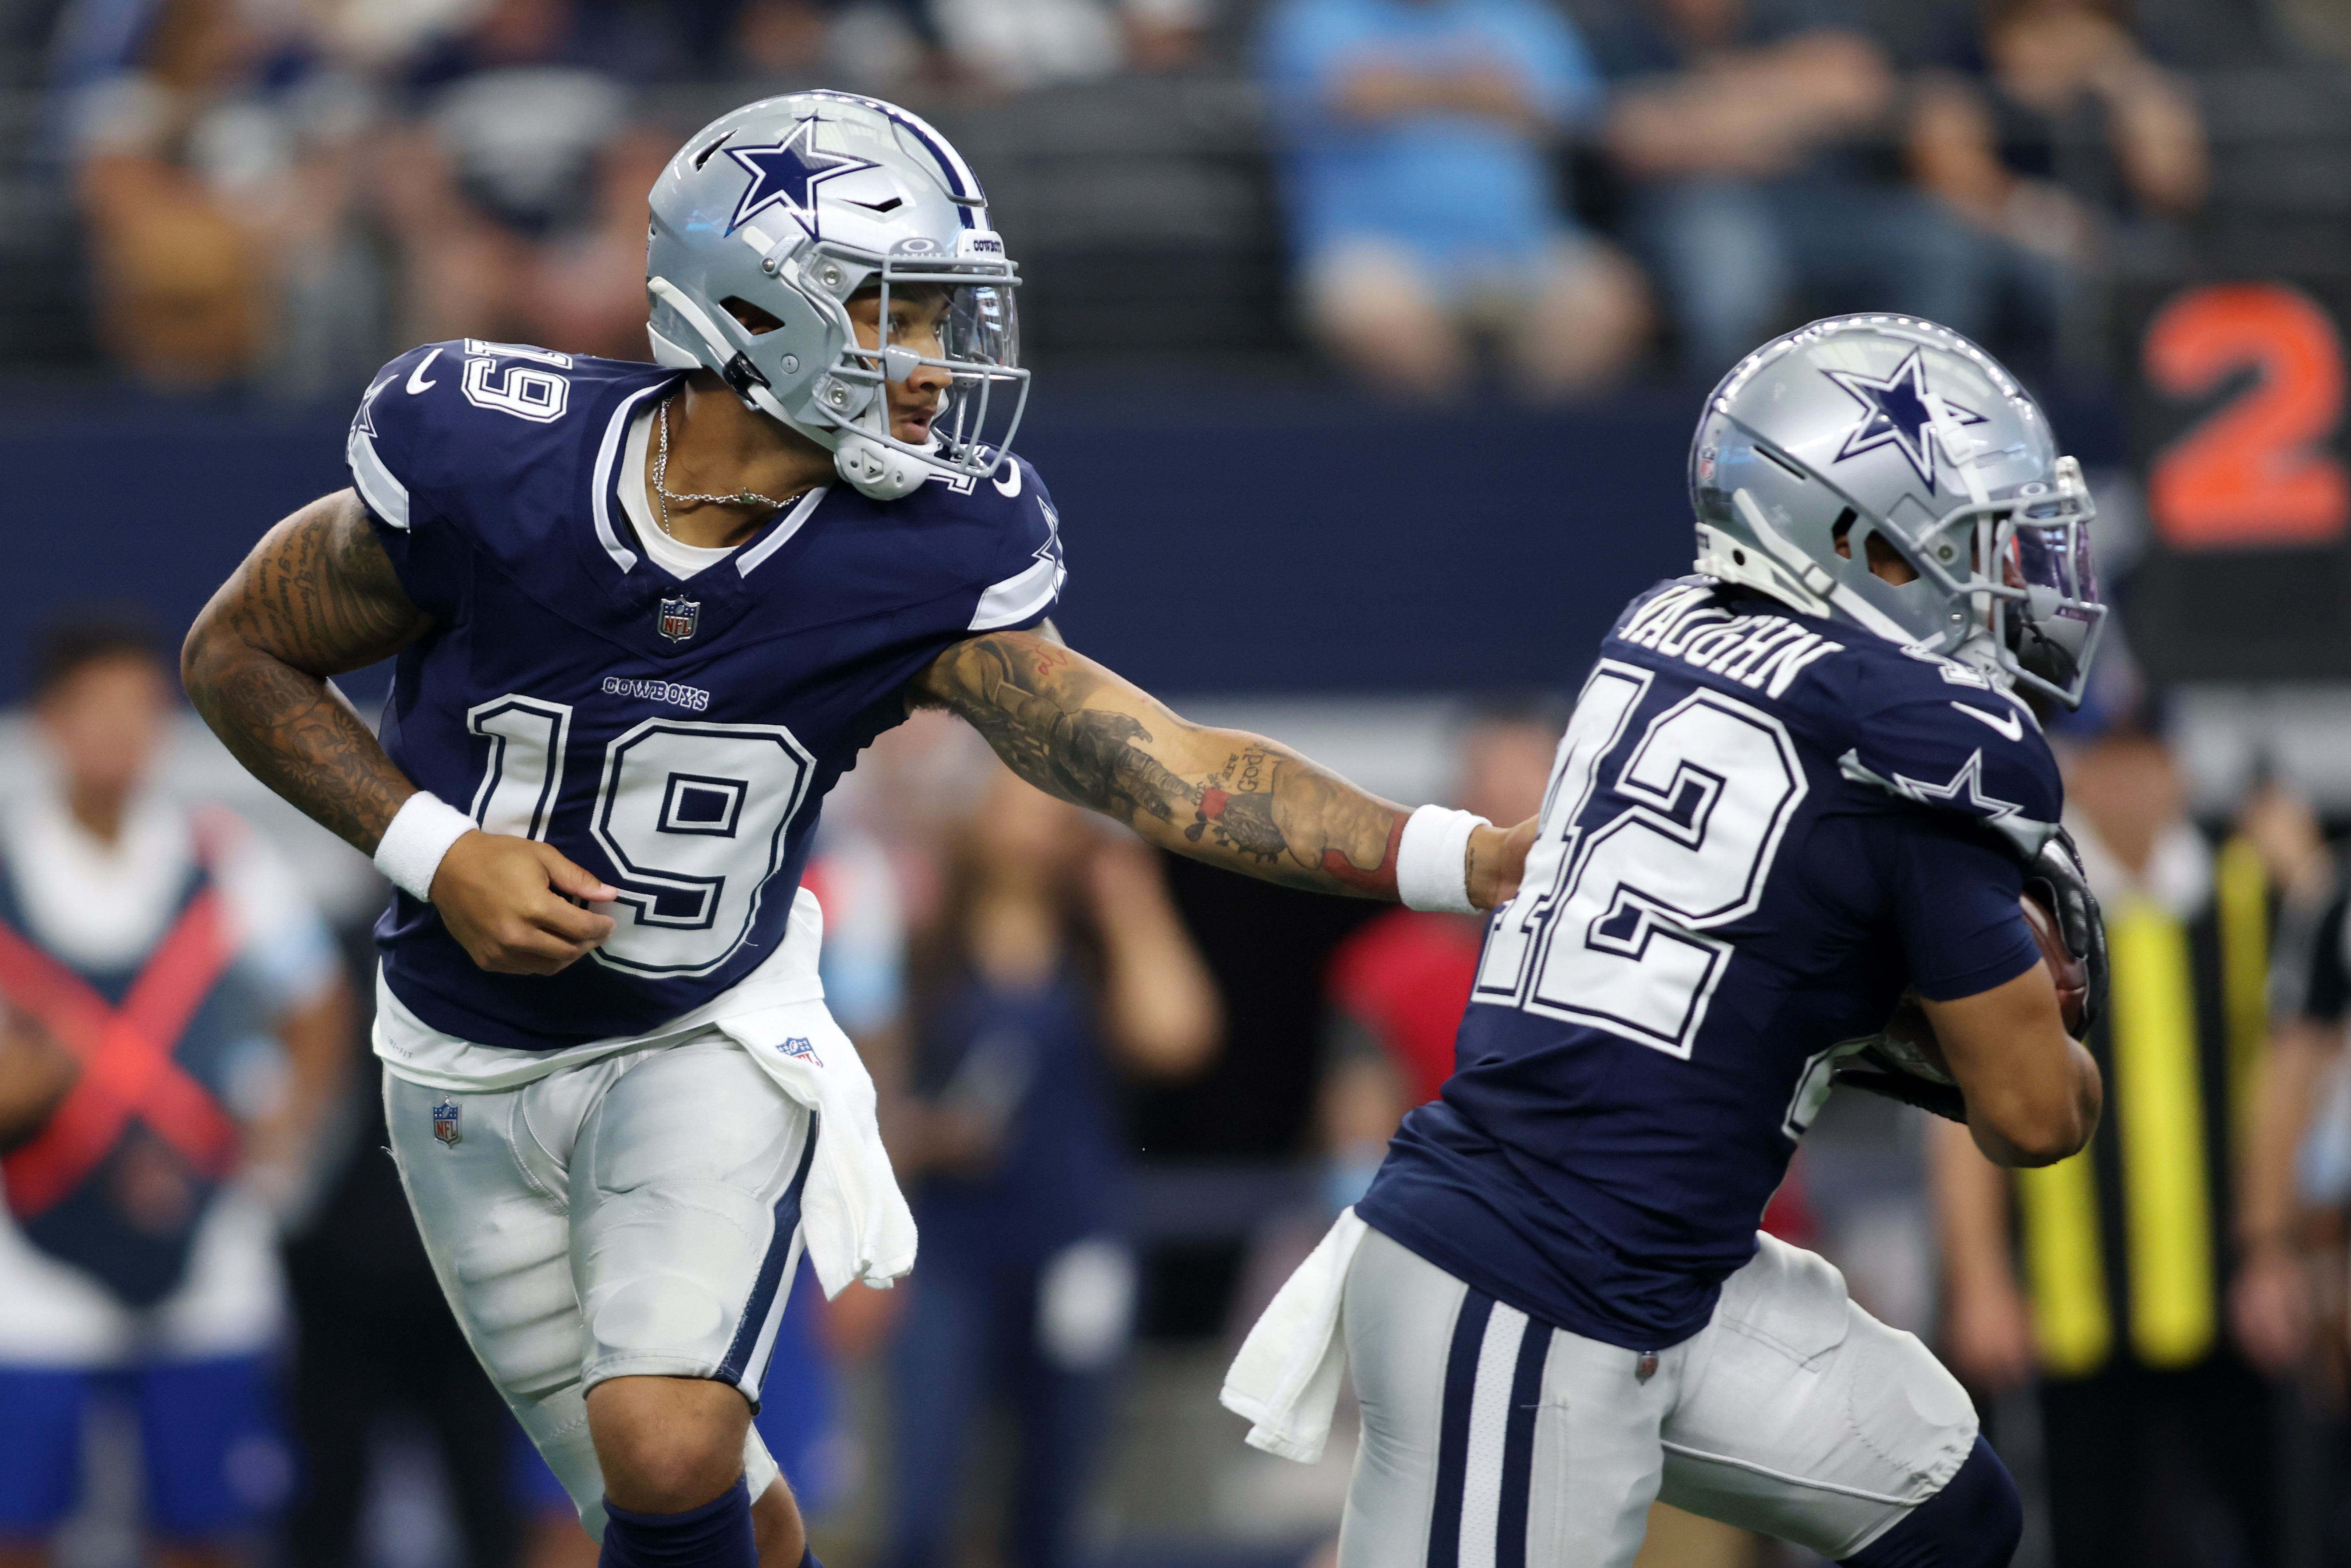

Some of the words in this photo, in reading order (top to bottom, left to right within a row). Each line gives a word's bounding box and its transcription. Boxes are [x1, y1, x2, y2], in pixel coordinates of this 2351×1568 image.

[461, 338, 573, 423] 19
[2143, 284, 2346, 548] 2
[664, 617, 691, 635] NFL
[1618, 585, 1845, 700] VAUGHN
[602, 676, 710, 711] COWBOYS
[467, 693, 817, 979] 19
[436, 1121, 456, 1139] NFL
